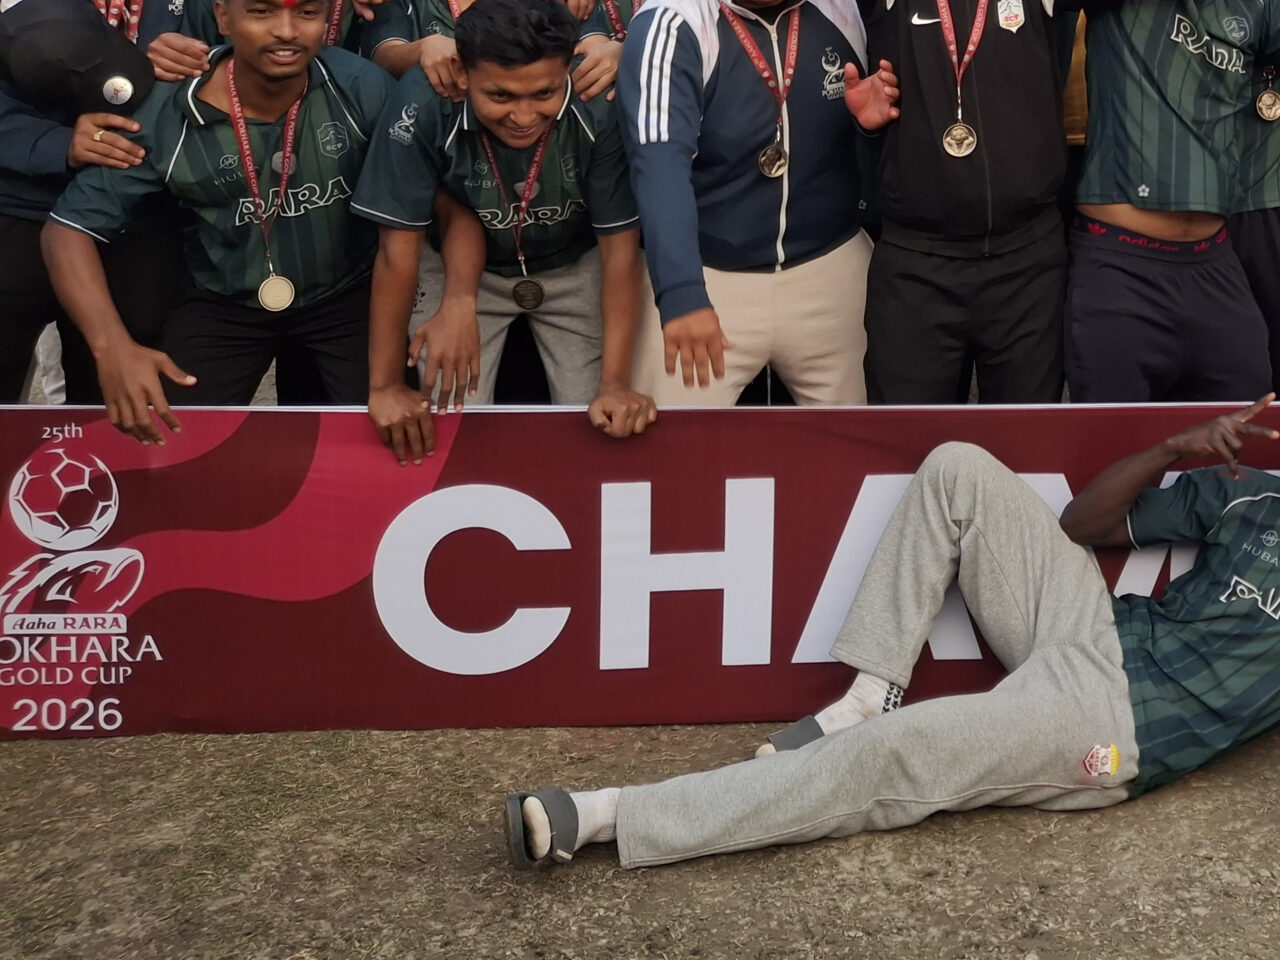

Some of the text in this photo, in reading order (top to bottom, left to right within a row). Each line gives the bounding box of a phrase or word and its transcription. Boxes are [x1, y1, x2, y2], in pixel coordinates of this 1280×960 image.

[604, 0, 617, 20] AAHA
[940, 6, 951, 28] AAHA
[974, 8, 984, 28] GOLD
[326, 25, 337, 46] GOLD
[729, 18, 758, 58] AAHA RARA
[789, 30, 798, 51] GOLD
[971, 27, 980, 43] CUP
[788, 51, 796, 65] CUP
[227, 72, 258, 194] AAHA RARA POKHARA GOLD CUP
[283, 120, 296, 157] POKHARA
[325, 142, 343, 151] SCP
[235, 176, 353, 227] RARA
[41, 423, 83, 443] 25th
[1241, 542, 1279, 567] HUBA
[12, 616, 123, 631] Aaha RARA
[0, 635, 163, 664] OKHARA
[0, 666, 132, 686] GOLD CUP
[12, 697, 124, 732] 2026
